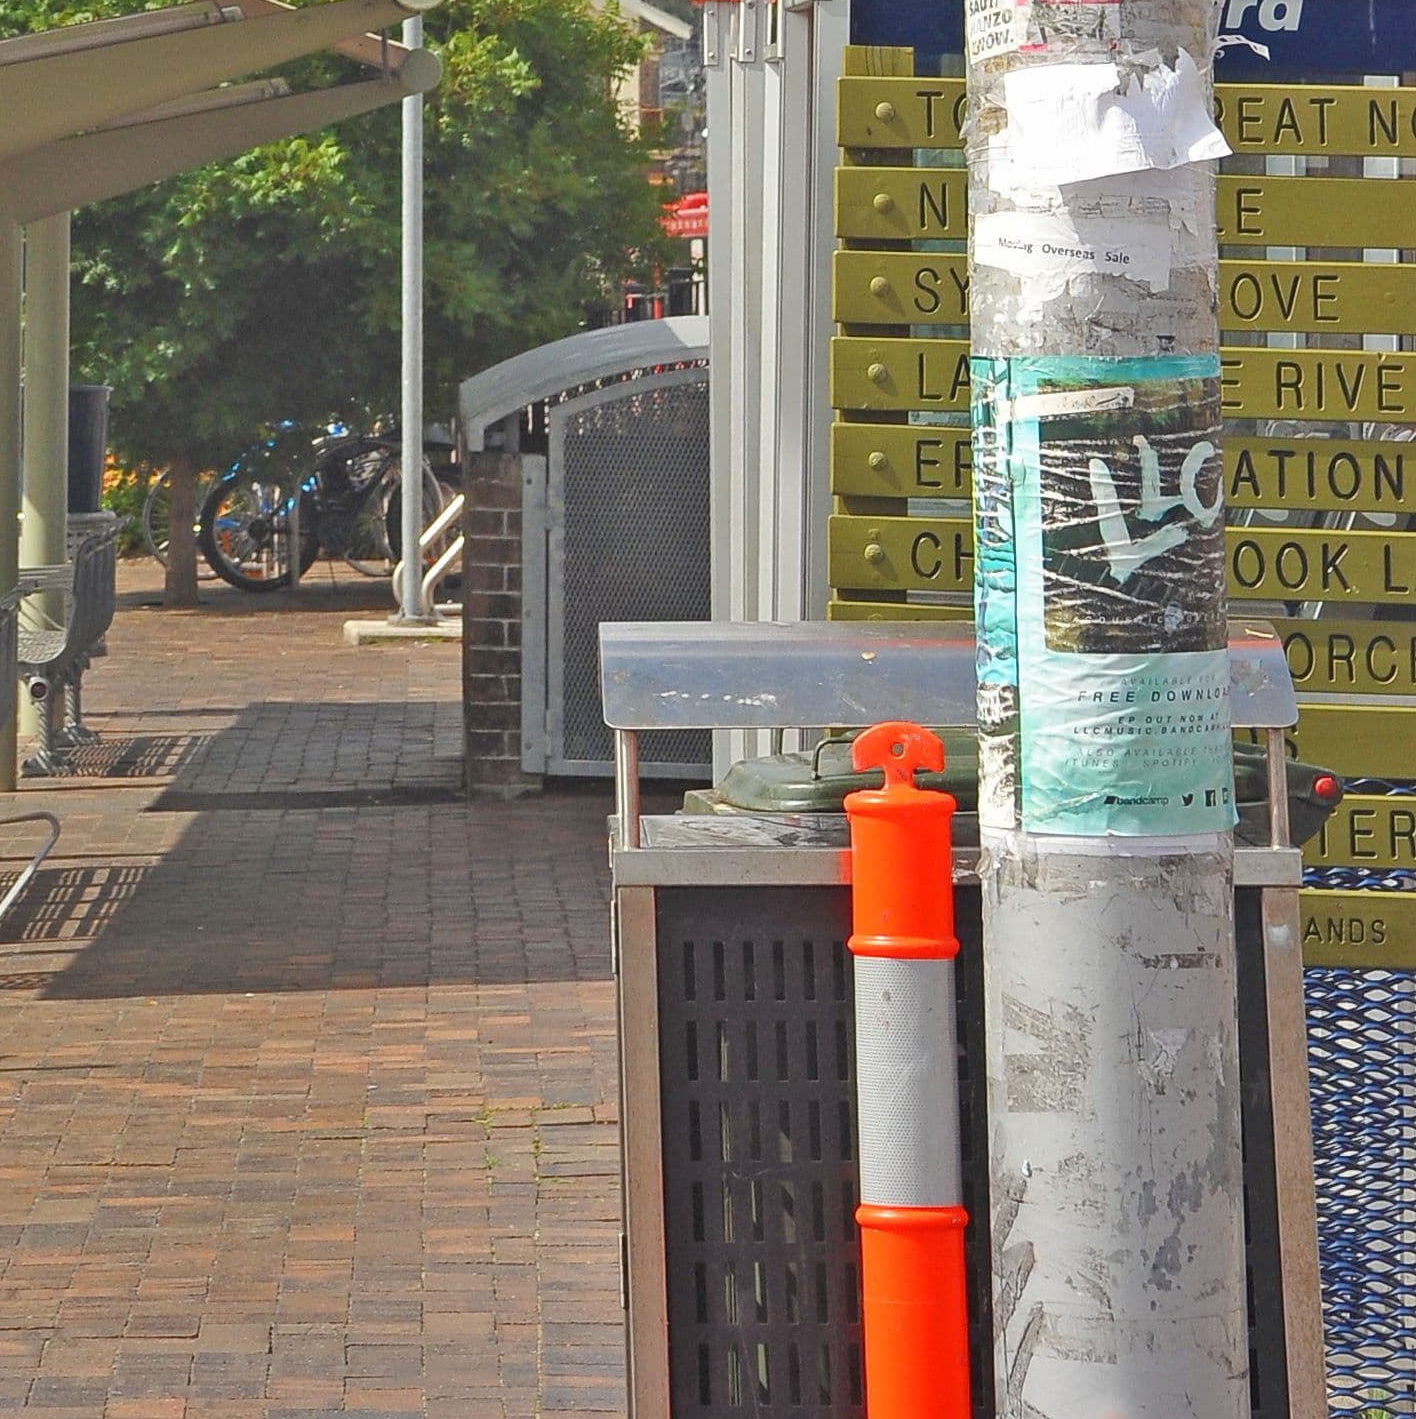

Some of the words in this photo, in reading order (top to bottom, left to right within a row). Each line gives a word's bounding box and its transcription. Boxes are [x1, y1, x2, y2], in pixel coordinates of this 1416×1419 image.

[1041, 243, 1096, 260] Overseas
[1104, 250, 1130, 265] Sale
[913, 267, 970, 314] SY
[1230, 272, 1341, 323] OVE
[1220, 360, 1244, 409] E
[1230, 448, 1405, 503] ATION
[911, 531, 974, 582] CH
[1232, 539, 1352, 593] OOK
[1284, 631, 1416, 685] ORC
[1077, 690, 1136, 704] FREE
[1117, 715, 1136, 725] EP
[1145, 714, 1172, 725] OUT
[1179, 713, 1204, 724] NOW
[1124, 746, 1198, 758] AVAILABLE
[1115, 793, 1169, 807] bandcamp
[1303, 916, 1386, 945] ANDS
